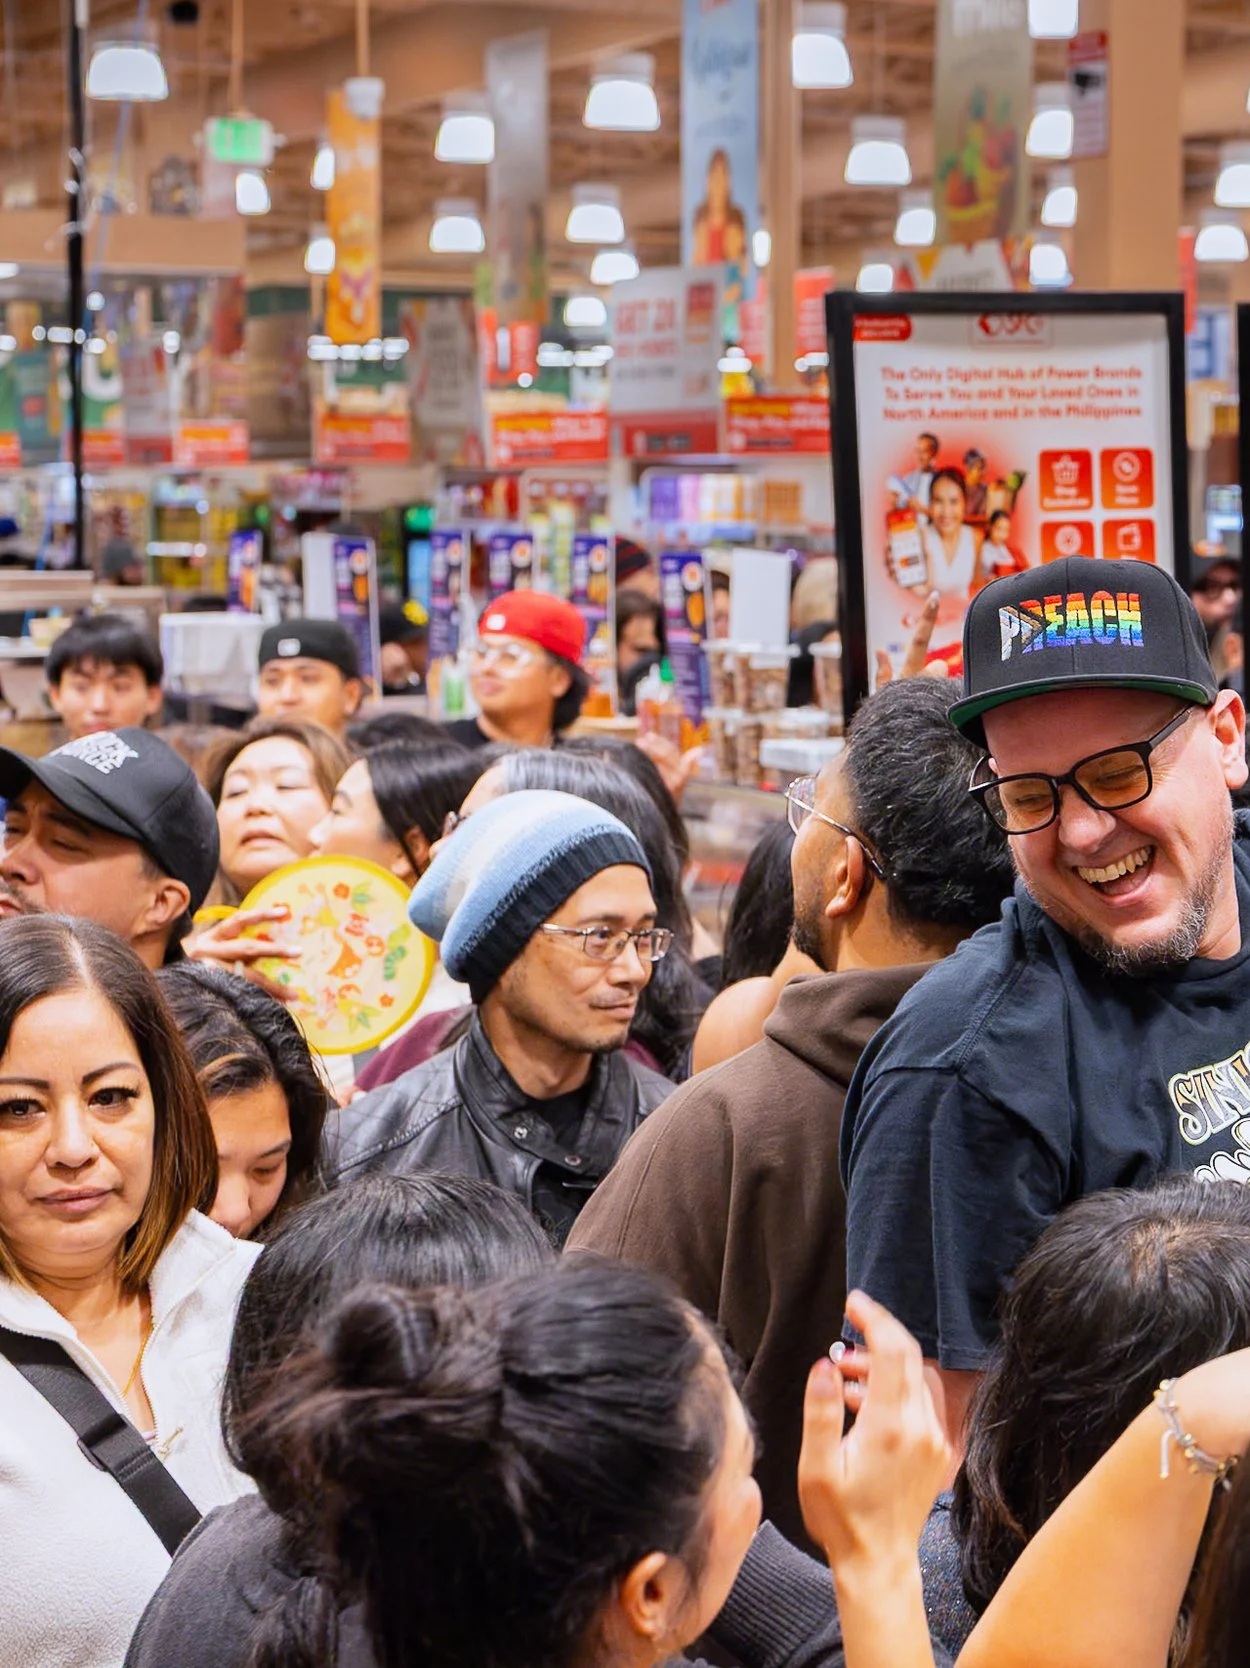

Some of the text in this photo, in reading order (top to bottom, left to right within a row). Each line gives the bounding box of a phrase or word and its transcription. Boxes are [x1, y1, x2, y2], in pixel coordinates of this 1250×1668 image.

[881, 365, 1142, 383] The Only Digital Hub of Power Brands
[885, 384, 1139, 400] To Serve You and Your Loved Ones in
[883, 404, 1142, 420] North America and in the Philippines
[999, 591, 1145, 661] PREACH
